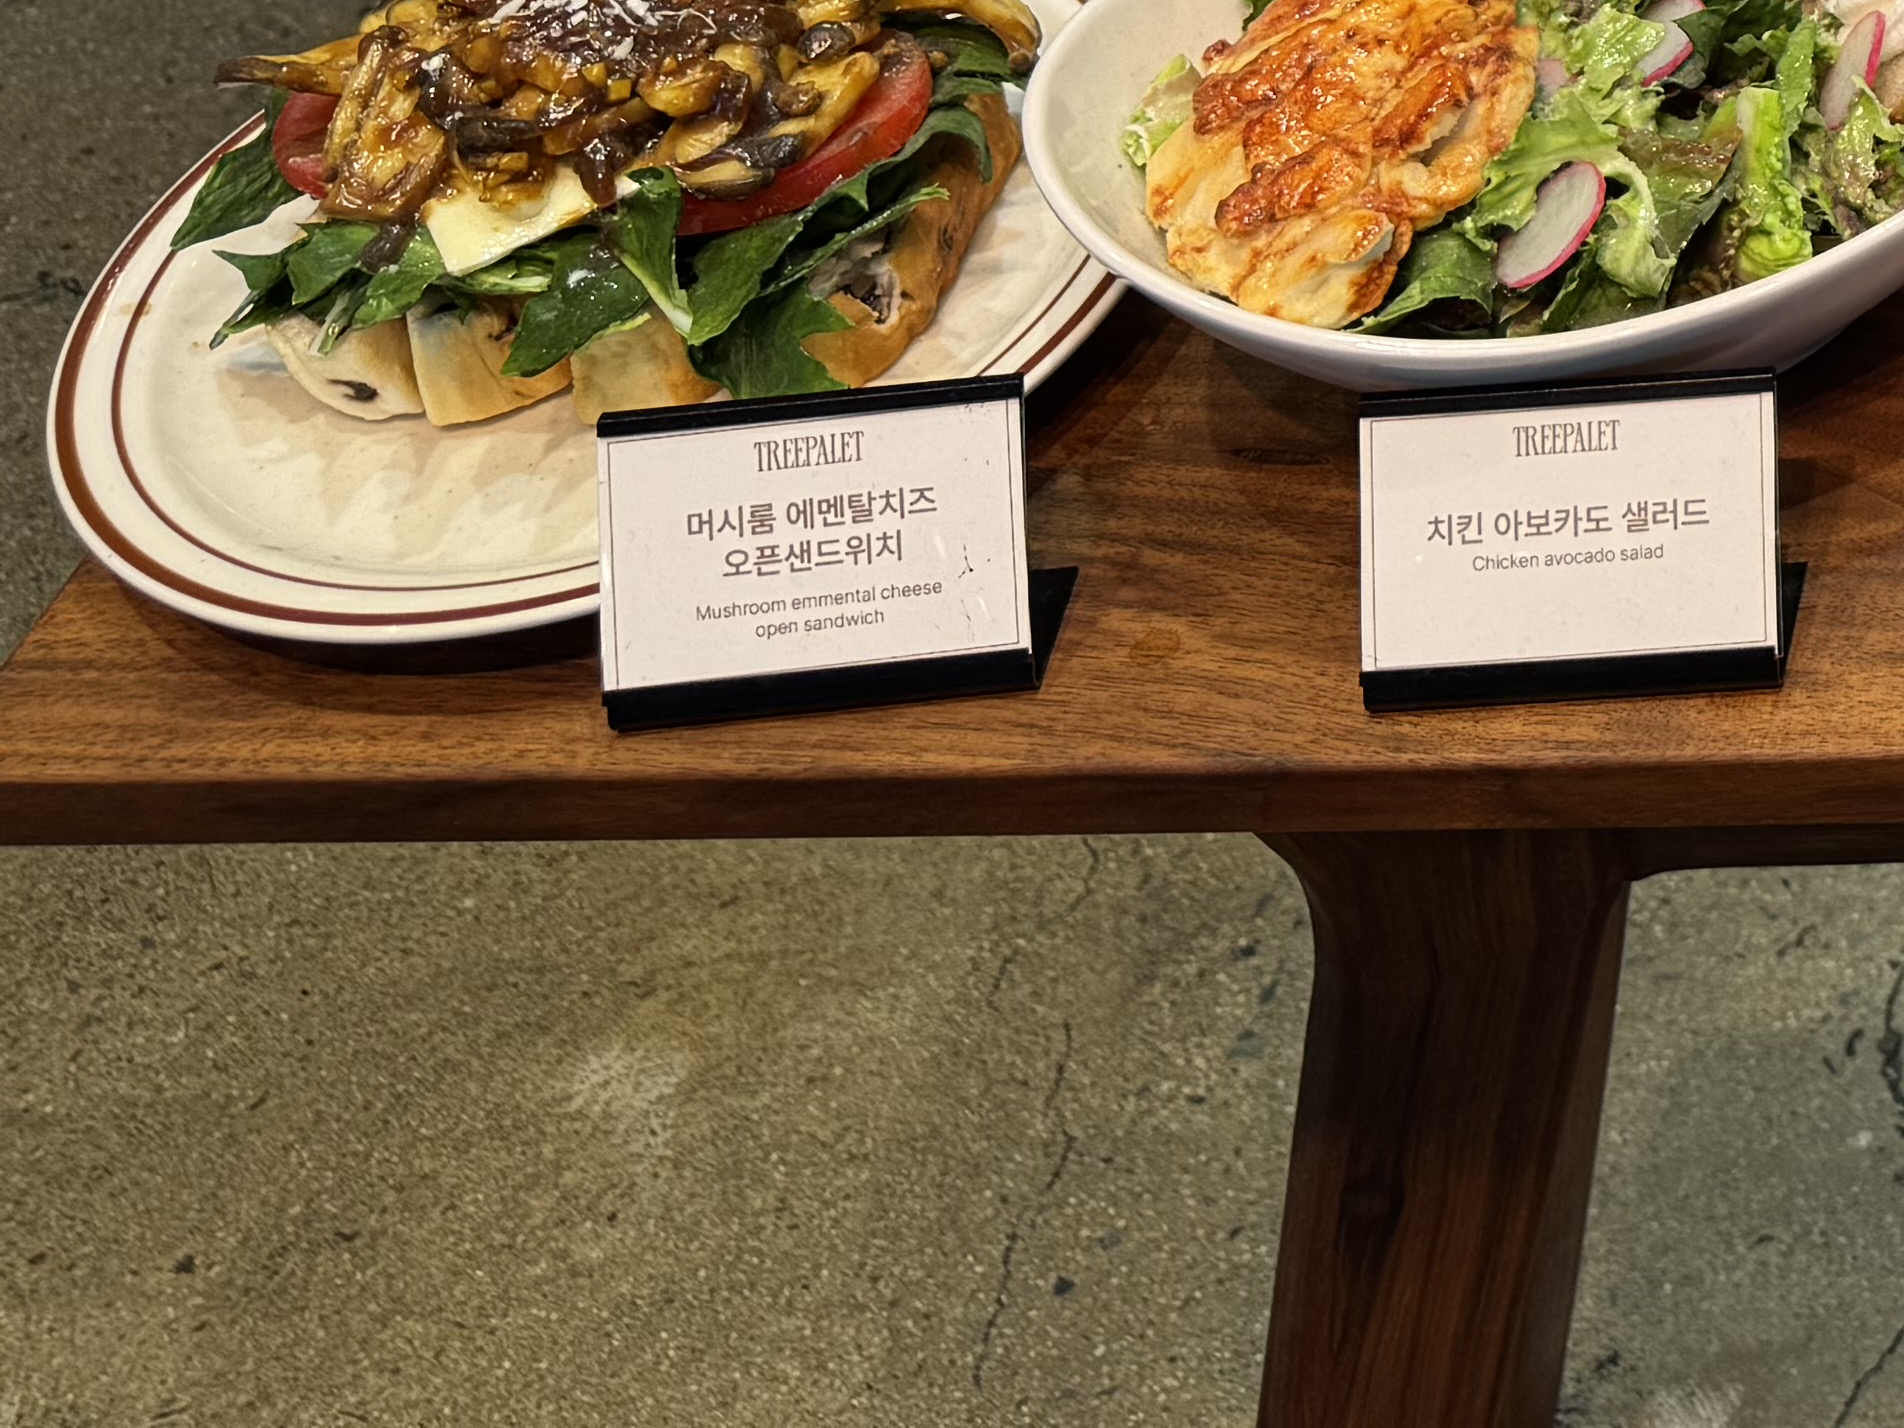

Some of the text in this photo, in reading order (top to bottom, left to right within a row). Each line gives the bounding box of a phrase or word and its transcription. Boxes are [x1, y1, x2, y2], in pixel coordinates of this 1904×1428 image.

[754, 431, 864, 472] TREEPALET
[1513, 419, 1620, 458] TREEPALET
[686, 486, 938, 541] 머시룸 에멘탈치즈
[1426, 498, 1710, 546] 치킨 아보카도 샐러드
[722, 529, 903, 578] 오픈샌드위치
[1473, 544, 1664, 572] Chicken avocado salad
[696, 580, 942, 621] Mushroom emmental cheese
[755, 609, 884, 640] open sandwich
